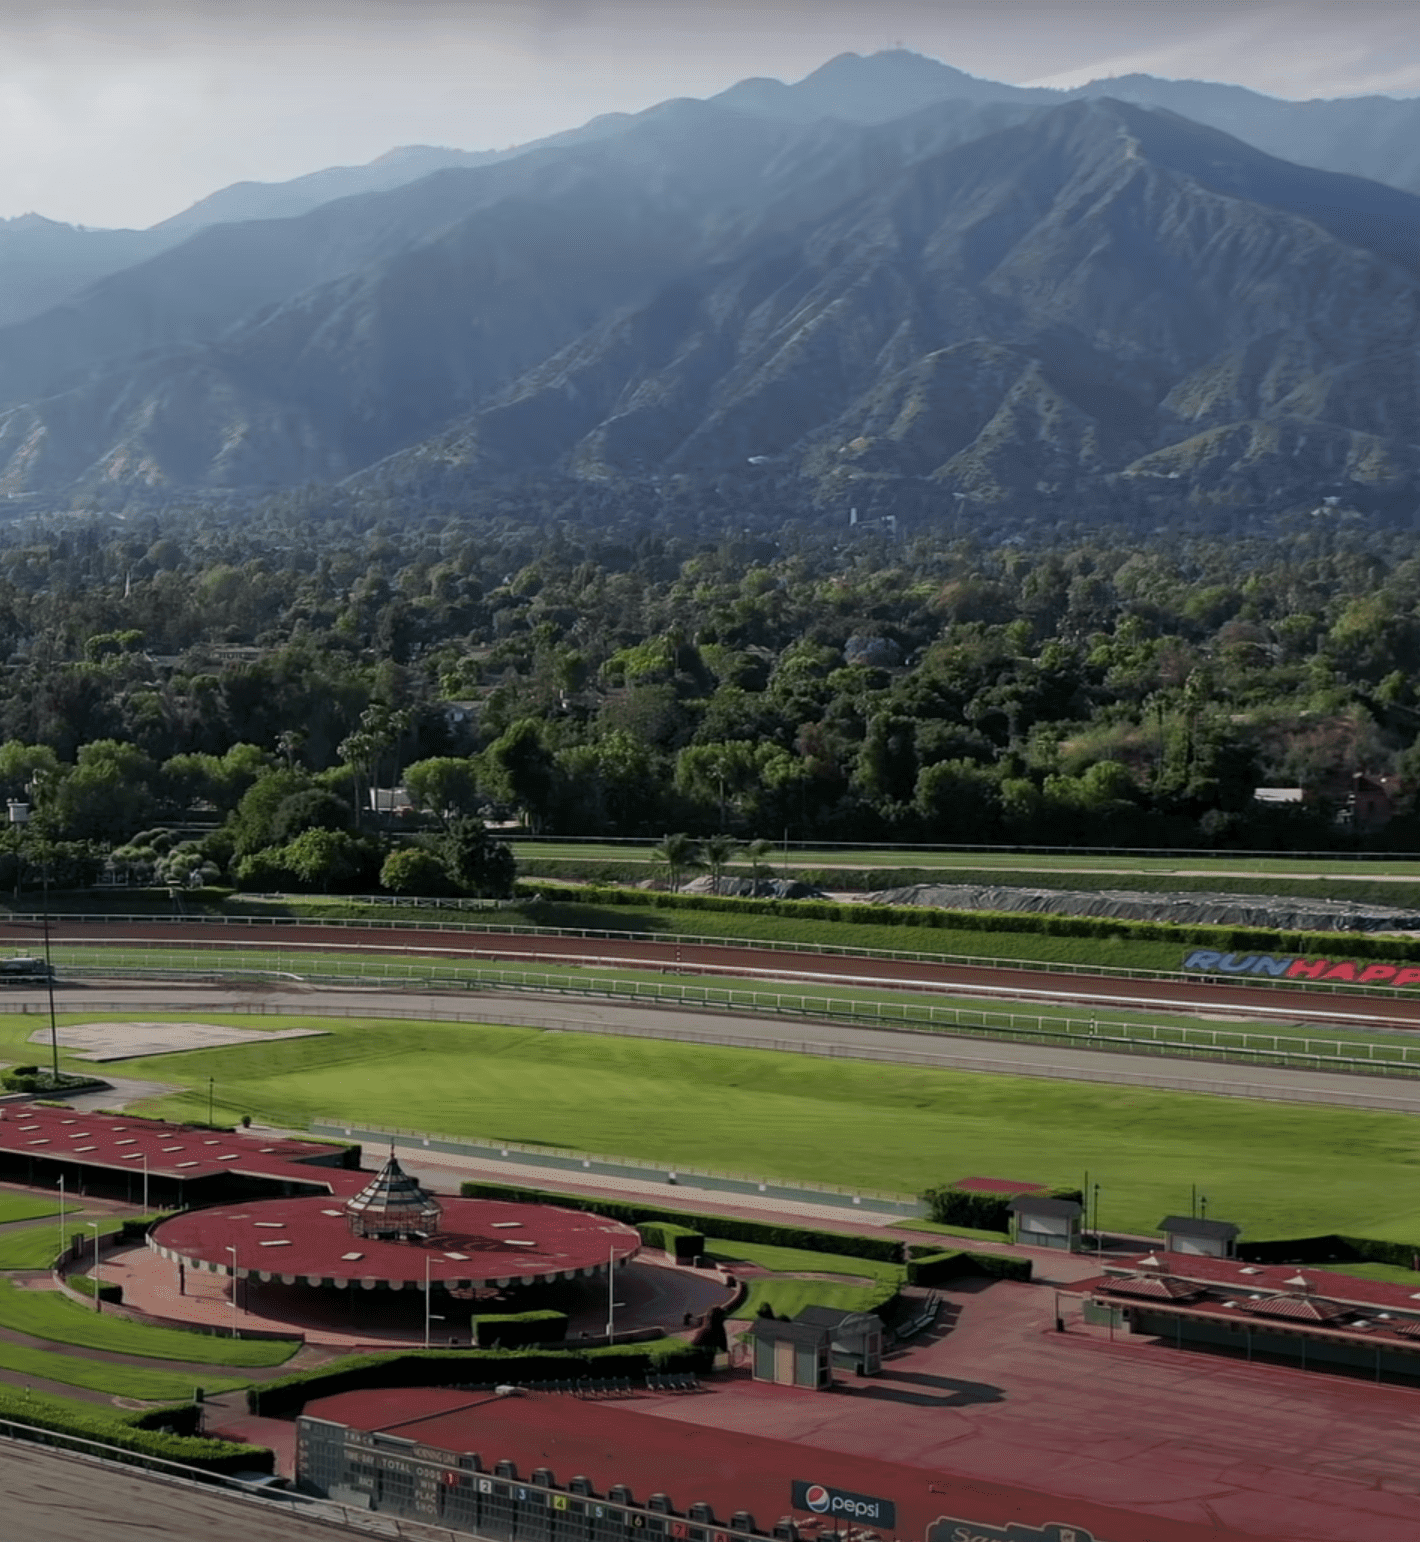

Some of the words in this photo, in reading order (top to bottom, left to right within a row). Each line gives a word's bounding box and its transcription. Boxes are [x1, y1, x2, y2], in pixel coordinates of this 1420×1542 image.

[382, 1458, 411, 1473] TOTAL
[416, 1467, 442, 1481] ODDS
[421, 1480, 437, 1491] WIN
[595, 1506, 603, 1518] 5
[634, 1515, 643, 1528] 6
[832, 1496, 879, 1518] pepsi
